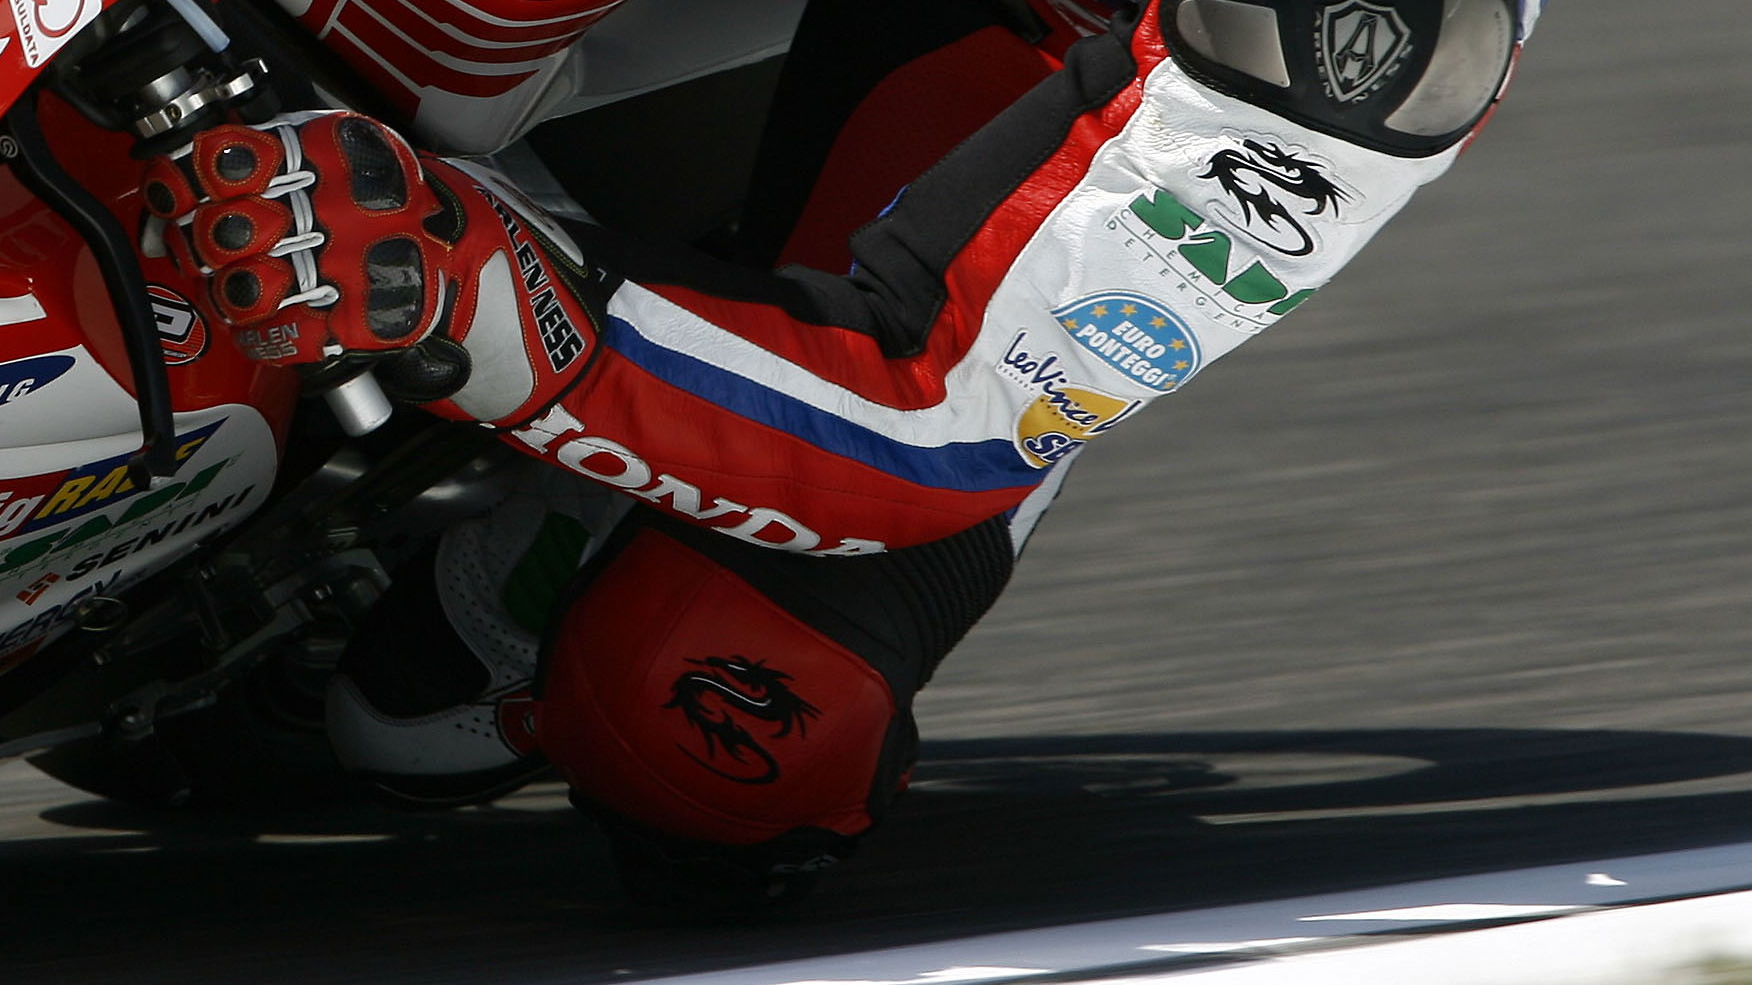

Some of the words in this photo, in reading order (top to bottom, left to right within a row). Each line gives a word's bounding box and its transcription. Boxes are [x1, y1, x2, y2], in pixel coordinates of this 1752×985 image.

[529, 285, 586, 375] NESS
[1075, 323, 1171, 387] PONTEGGI
[1111, 320, 1166, 360] EURO
[66, 484, 257, 581] SENINI
